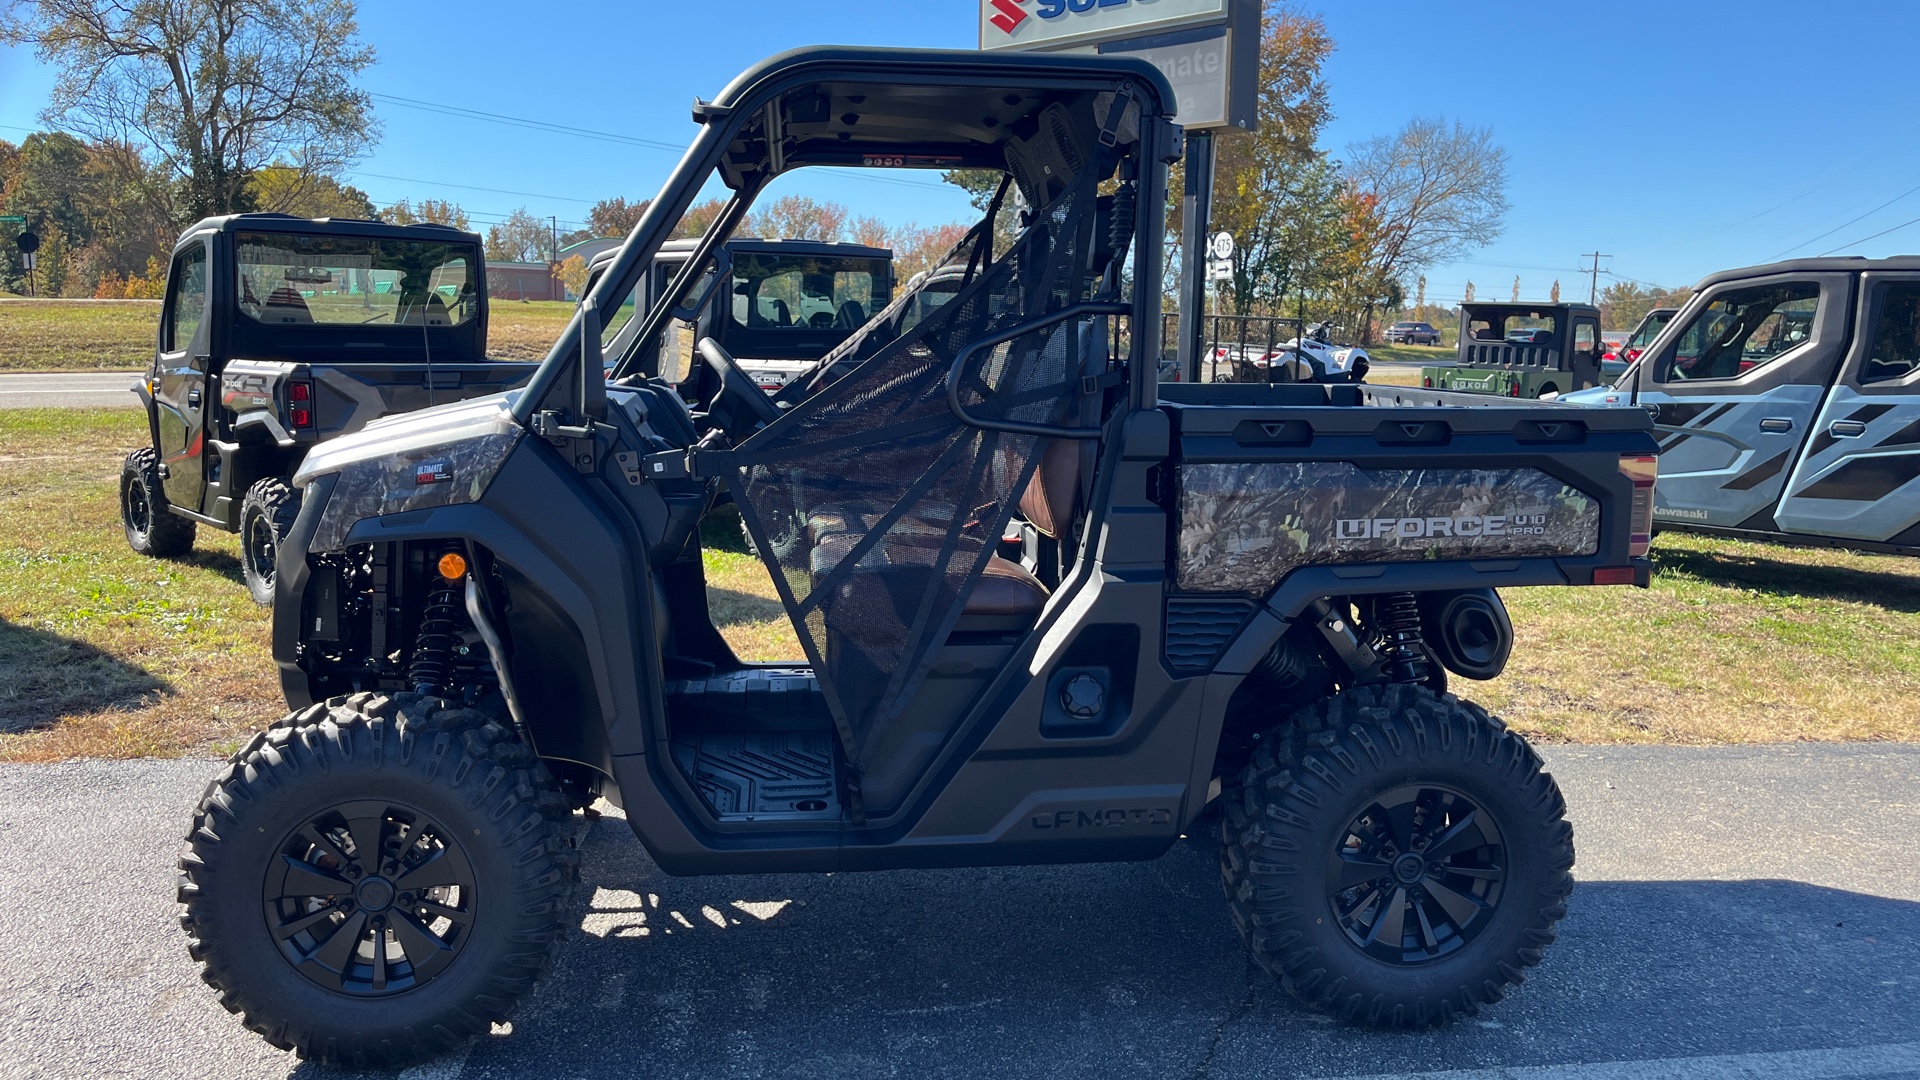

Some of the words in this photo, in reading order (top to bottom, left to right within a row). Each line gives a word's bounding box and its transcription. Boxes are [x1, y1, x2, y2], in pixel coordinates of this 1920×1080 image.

[1216, 239, 1231, 251] 675
[1451, 380, 1489, 390] ROXOR
[417, 463, 443, 474] ULTIMATE
[418, 473, 434, 483] CYCLE
[1652, 505, 1708, 519] Kawasaki
[1512, 526, 1545, 535] PRO
[1031, 808, 1171, 829] CFMOTO
